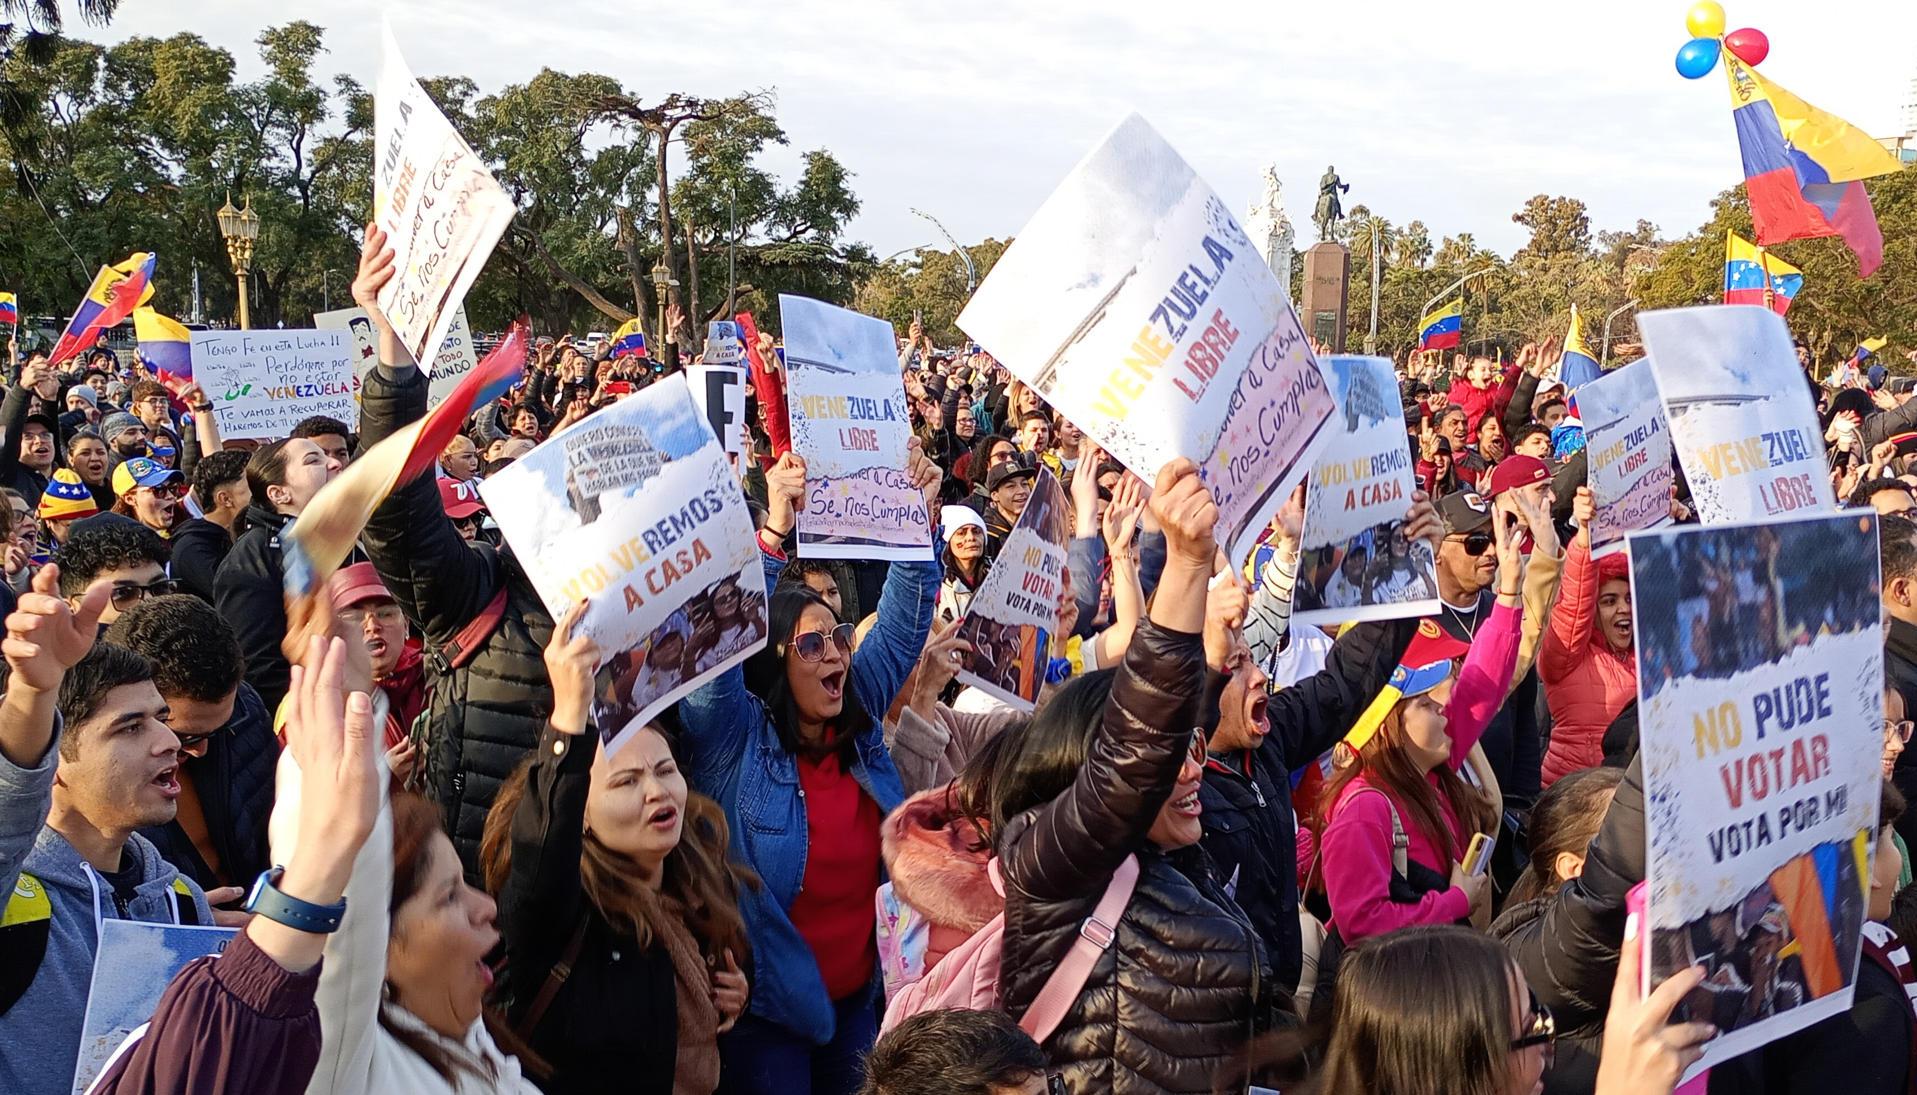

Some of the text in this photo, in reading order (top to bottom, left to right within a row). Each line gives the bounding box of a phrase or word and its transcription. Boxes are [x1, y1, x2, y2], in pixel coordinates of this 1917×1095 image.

[388, 156, 417, 233] LIBRE
[400, 291, 419, 324] Se
[418, 252, 440, 288] nos
[1091, 235, 1234, 420] VENEZUELA
[331, 358, 349, 371] por
[438, 351, 463, 363] TODO
[1172, 308, 1240, 404] LIBRE
[1248, 369, 1263, 390] a
[1261, 329, 1299, 372] Casa
[263, 381, 349, 400] VENEZUELA
[279, 371, 341, 385] no estar
[241, 406, 275, 419] VAMOS
[279, 405, 287, 415] A
[801, 395, 896, 421] VENEZUELA
[839, 427, 880, 451] LIBRE
[1595, 417, 1659, 470] VENEZUELA
[874, 471, 882, 486] a
[885, 471, 917, 490] Casa
[1213, 486, 1224, 507] e
[1228, 445, 1260, 484] nos
[1320, 448, 1407, 489] VOLVEREMOS
[1618, 447, 1648, 480] LIBRE
[810, 489, 835, 515] Se
[845, 497, 870, 516] nos
[1344, 478, 1402, 512] A CASA
[1759, 473, 1817, 515] LIBRE
[1599, 511, 1617, 529] Se
[561, 489, 723, 602] VOLVEREMOS
[1023, 544, 1041, 568] NO
[623, 537, 712, 614] A CASA
[1006, 591, 1032, 613] VOTA
[1031, 601, 1047, 619] POR
[1693, 672, 1832, 760] NO PUDE
[1719, 733, 1831, 809] VOTAR
[1707, 812, 1773, 864] VOTA
[1779, 796, 1820, 840] POR
